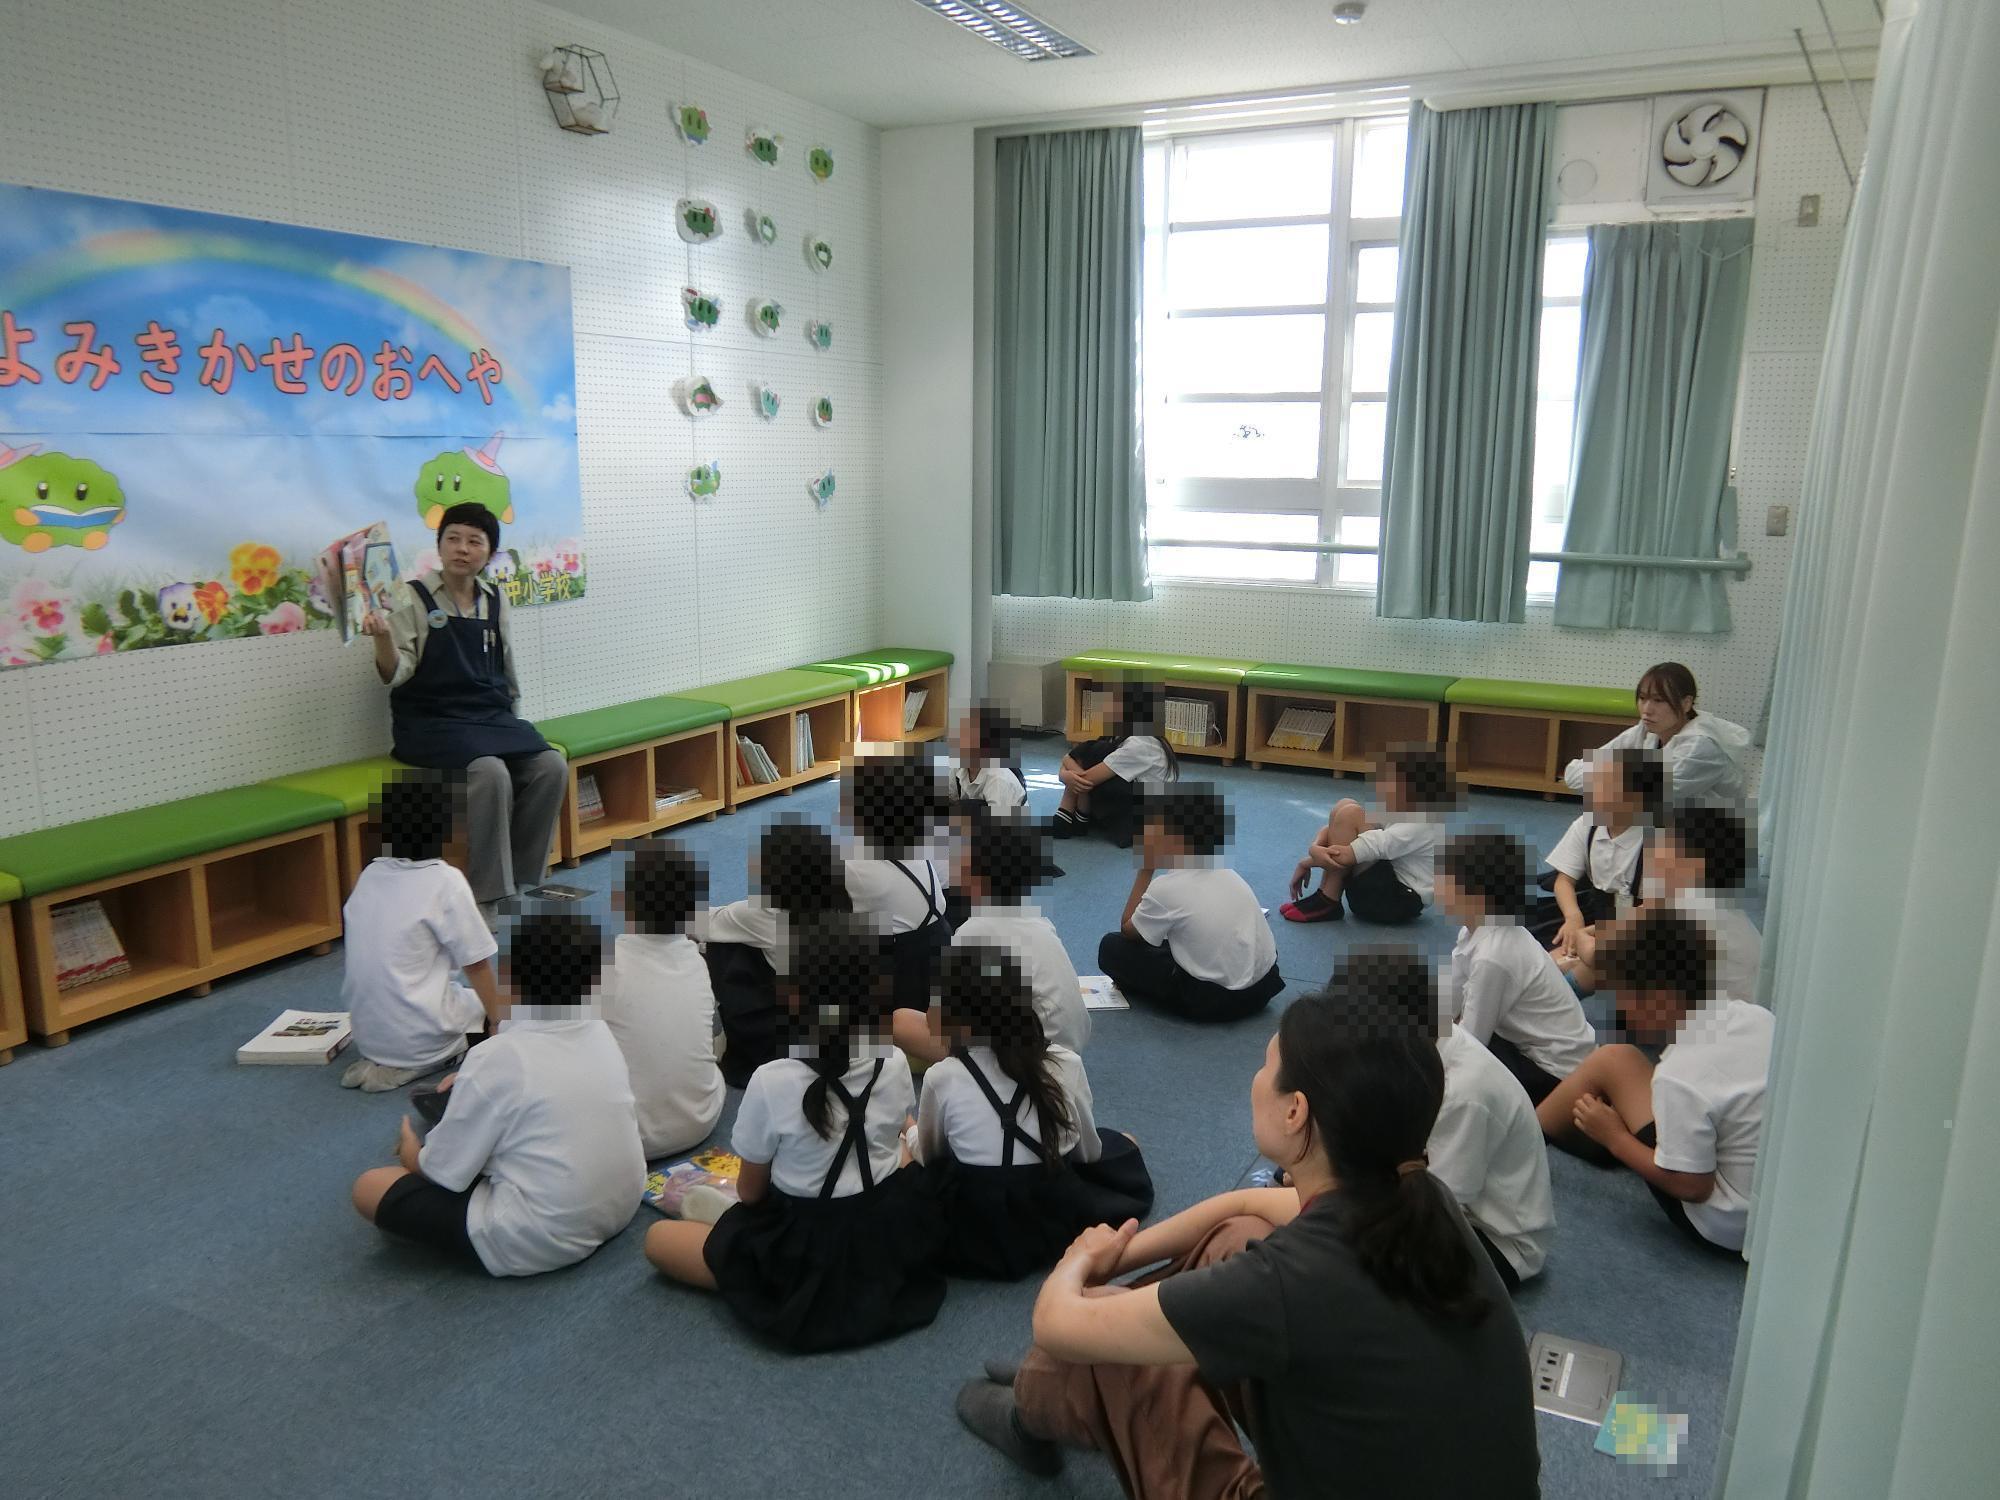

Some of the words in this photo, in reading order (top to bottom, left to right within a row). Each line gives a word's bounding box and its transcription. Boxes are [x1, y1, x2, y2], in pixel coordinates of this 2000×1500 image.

[0, 310, 502, 405] よみきかせのおへや
[491, 570, 571, 607] 中小学校
